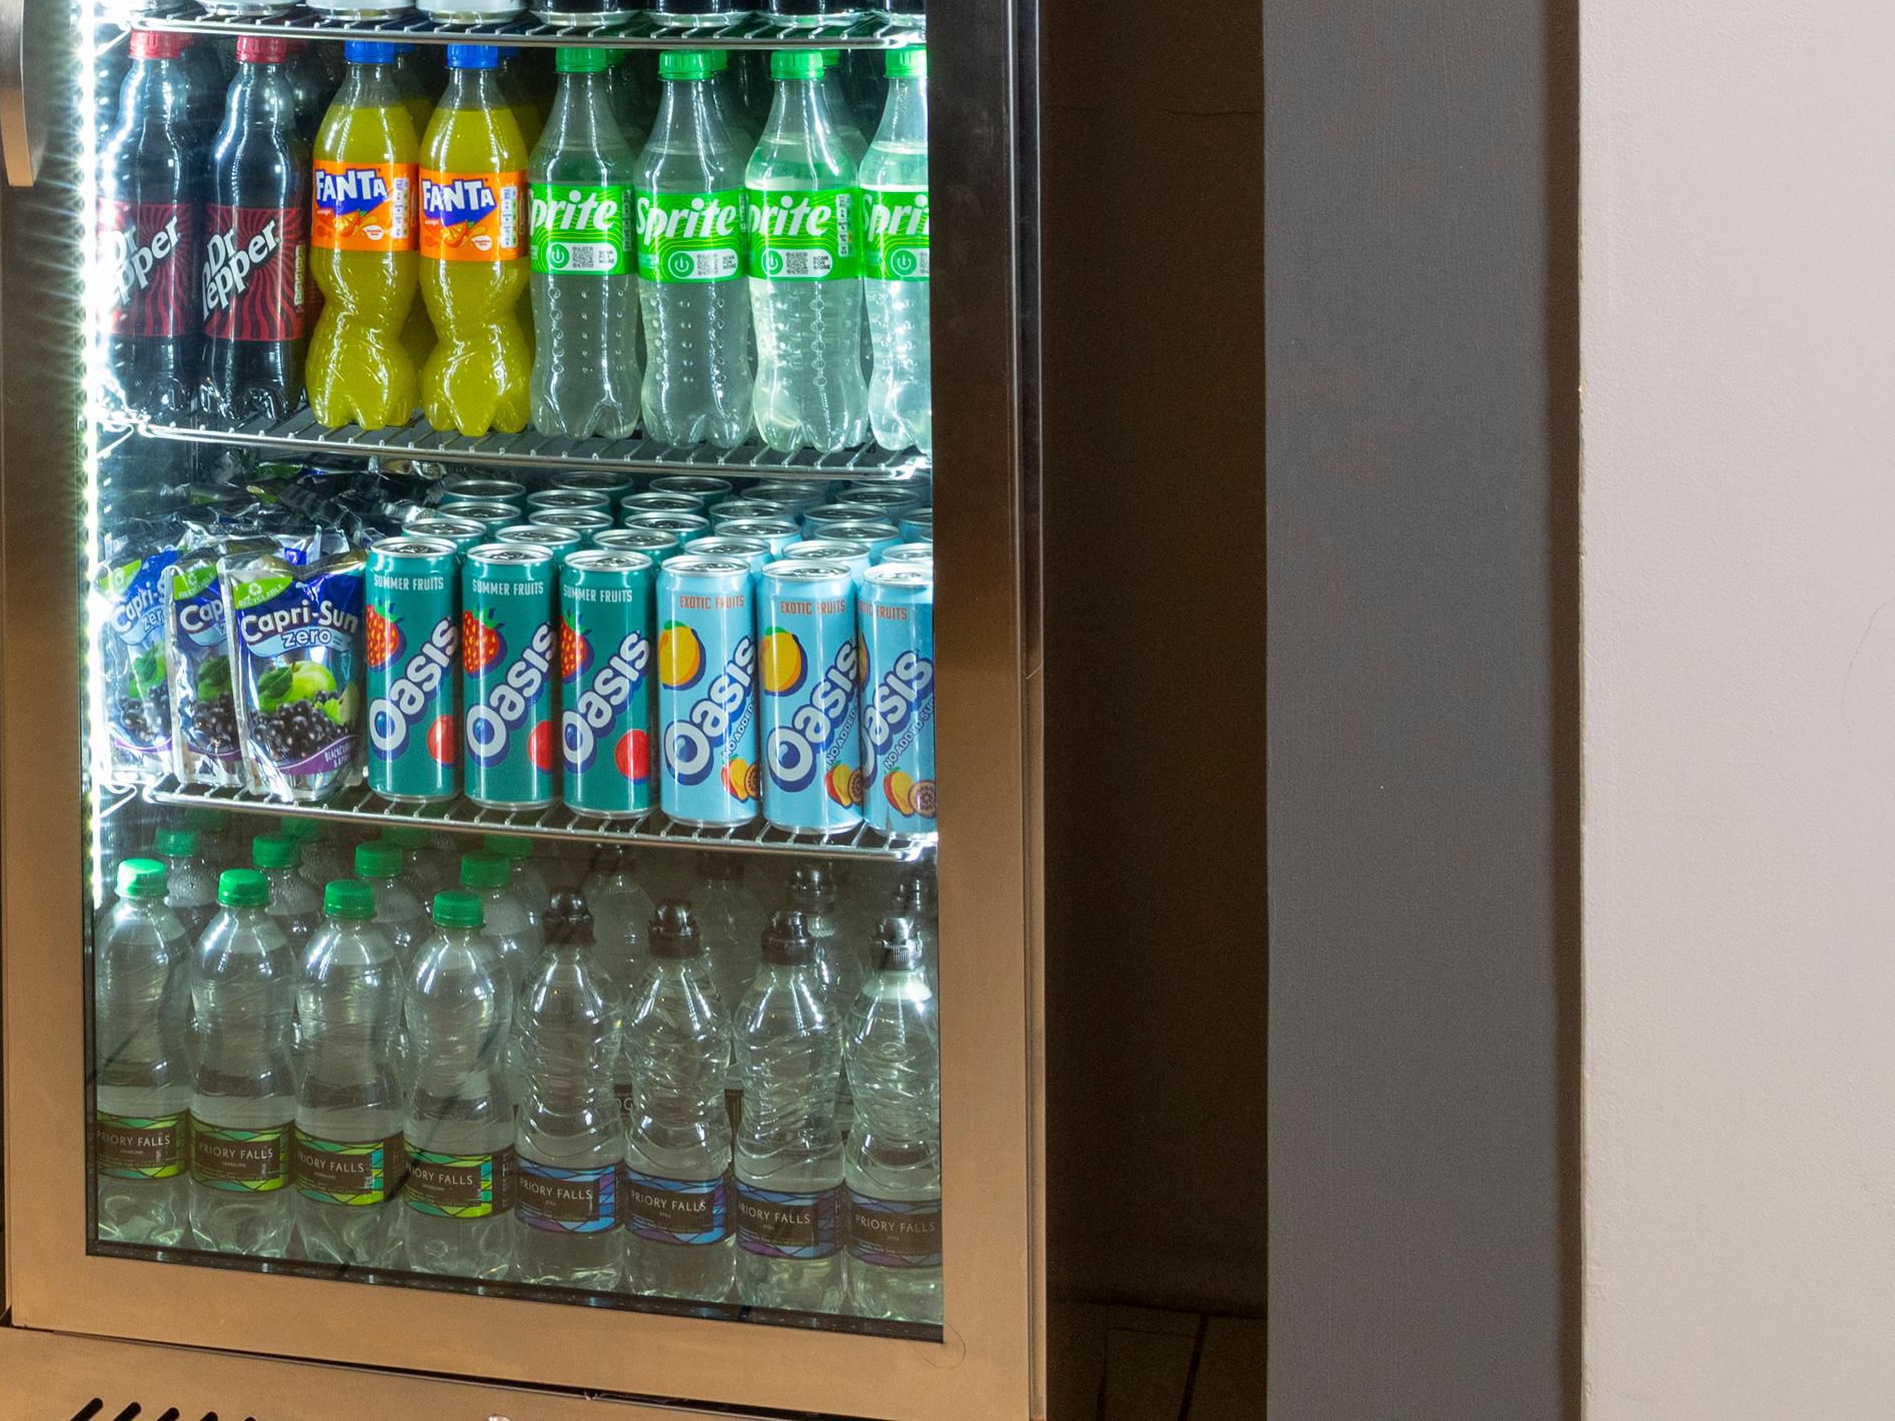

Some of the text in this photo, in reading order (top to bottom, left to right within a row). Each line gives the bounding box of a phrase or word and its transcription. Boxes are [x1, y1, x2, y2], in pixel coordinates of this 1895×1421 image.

[315, 170, 387, 202] FANTA
[422, 180, 496, 212] FANTA
[637, 198, 736, 246] Sprite
[207, 228, 237, 276] Dr
[202, 220, 278, 321] Pepper
[374, 577, 444, 590] SUMMER FRUITS
[472, 579, 544, 596] SUMMER FRUITS
[238, 584, 283, 608] RECYCLABLE
[563, 585, 632, 602] SUMMER FRUITS
[680, 595, 745, 610] EXOTIC FRUITS
[780, 600, 845, 615] EXOTIC FRUITS
[240, 600, 358, 642] Capri-Sun
[875, 605, 907, 620] FRUITS
[282, 626, 332, 648] zero
[826, 748, 840, 764] NO
[884, 751, 898, 769] NO
[138, 1134, 170, 1147] FALLS
[240, 1147, 273, 1159] FALLS
[330, 1162, 364, 1173] FALLS
[438, 1174, 473, 1185] FALLS
[520, 1178, 592, 1200] PRIORY FALLS
[631, 1189, 706, 1212] PRIORY FALLS
[775, 1213, 811, 1224] FALLS
[856, 1214, 936, 1233] PRIORY FALLS
